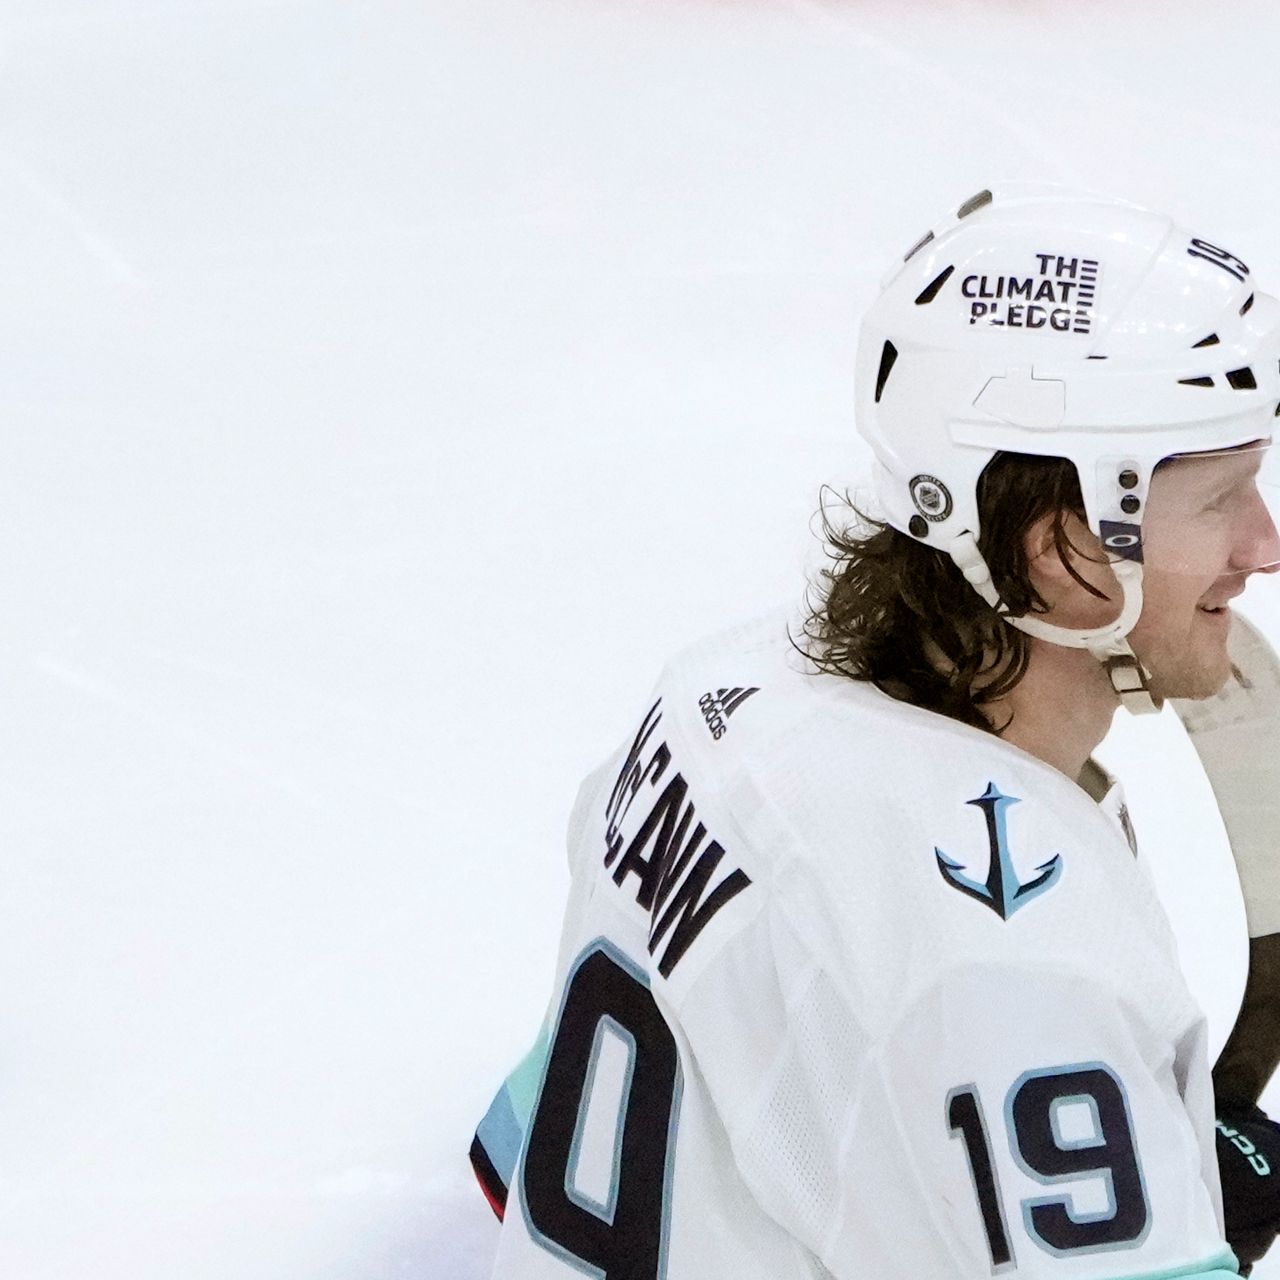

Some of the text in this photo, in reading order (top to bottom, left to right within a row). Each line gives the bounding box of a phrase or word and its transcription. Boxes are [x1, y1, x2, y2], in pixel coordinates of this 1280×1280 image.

[1036, 254, 1098, 281] THE
[961, 275, 1095, 307] CLIMATE
[970, 301, 1091, 334] PLEDGE
[698, 691, 728, 741] adidas
[944, 1059, 1154, 1277] 19
